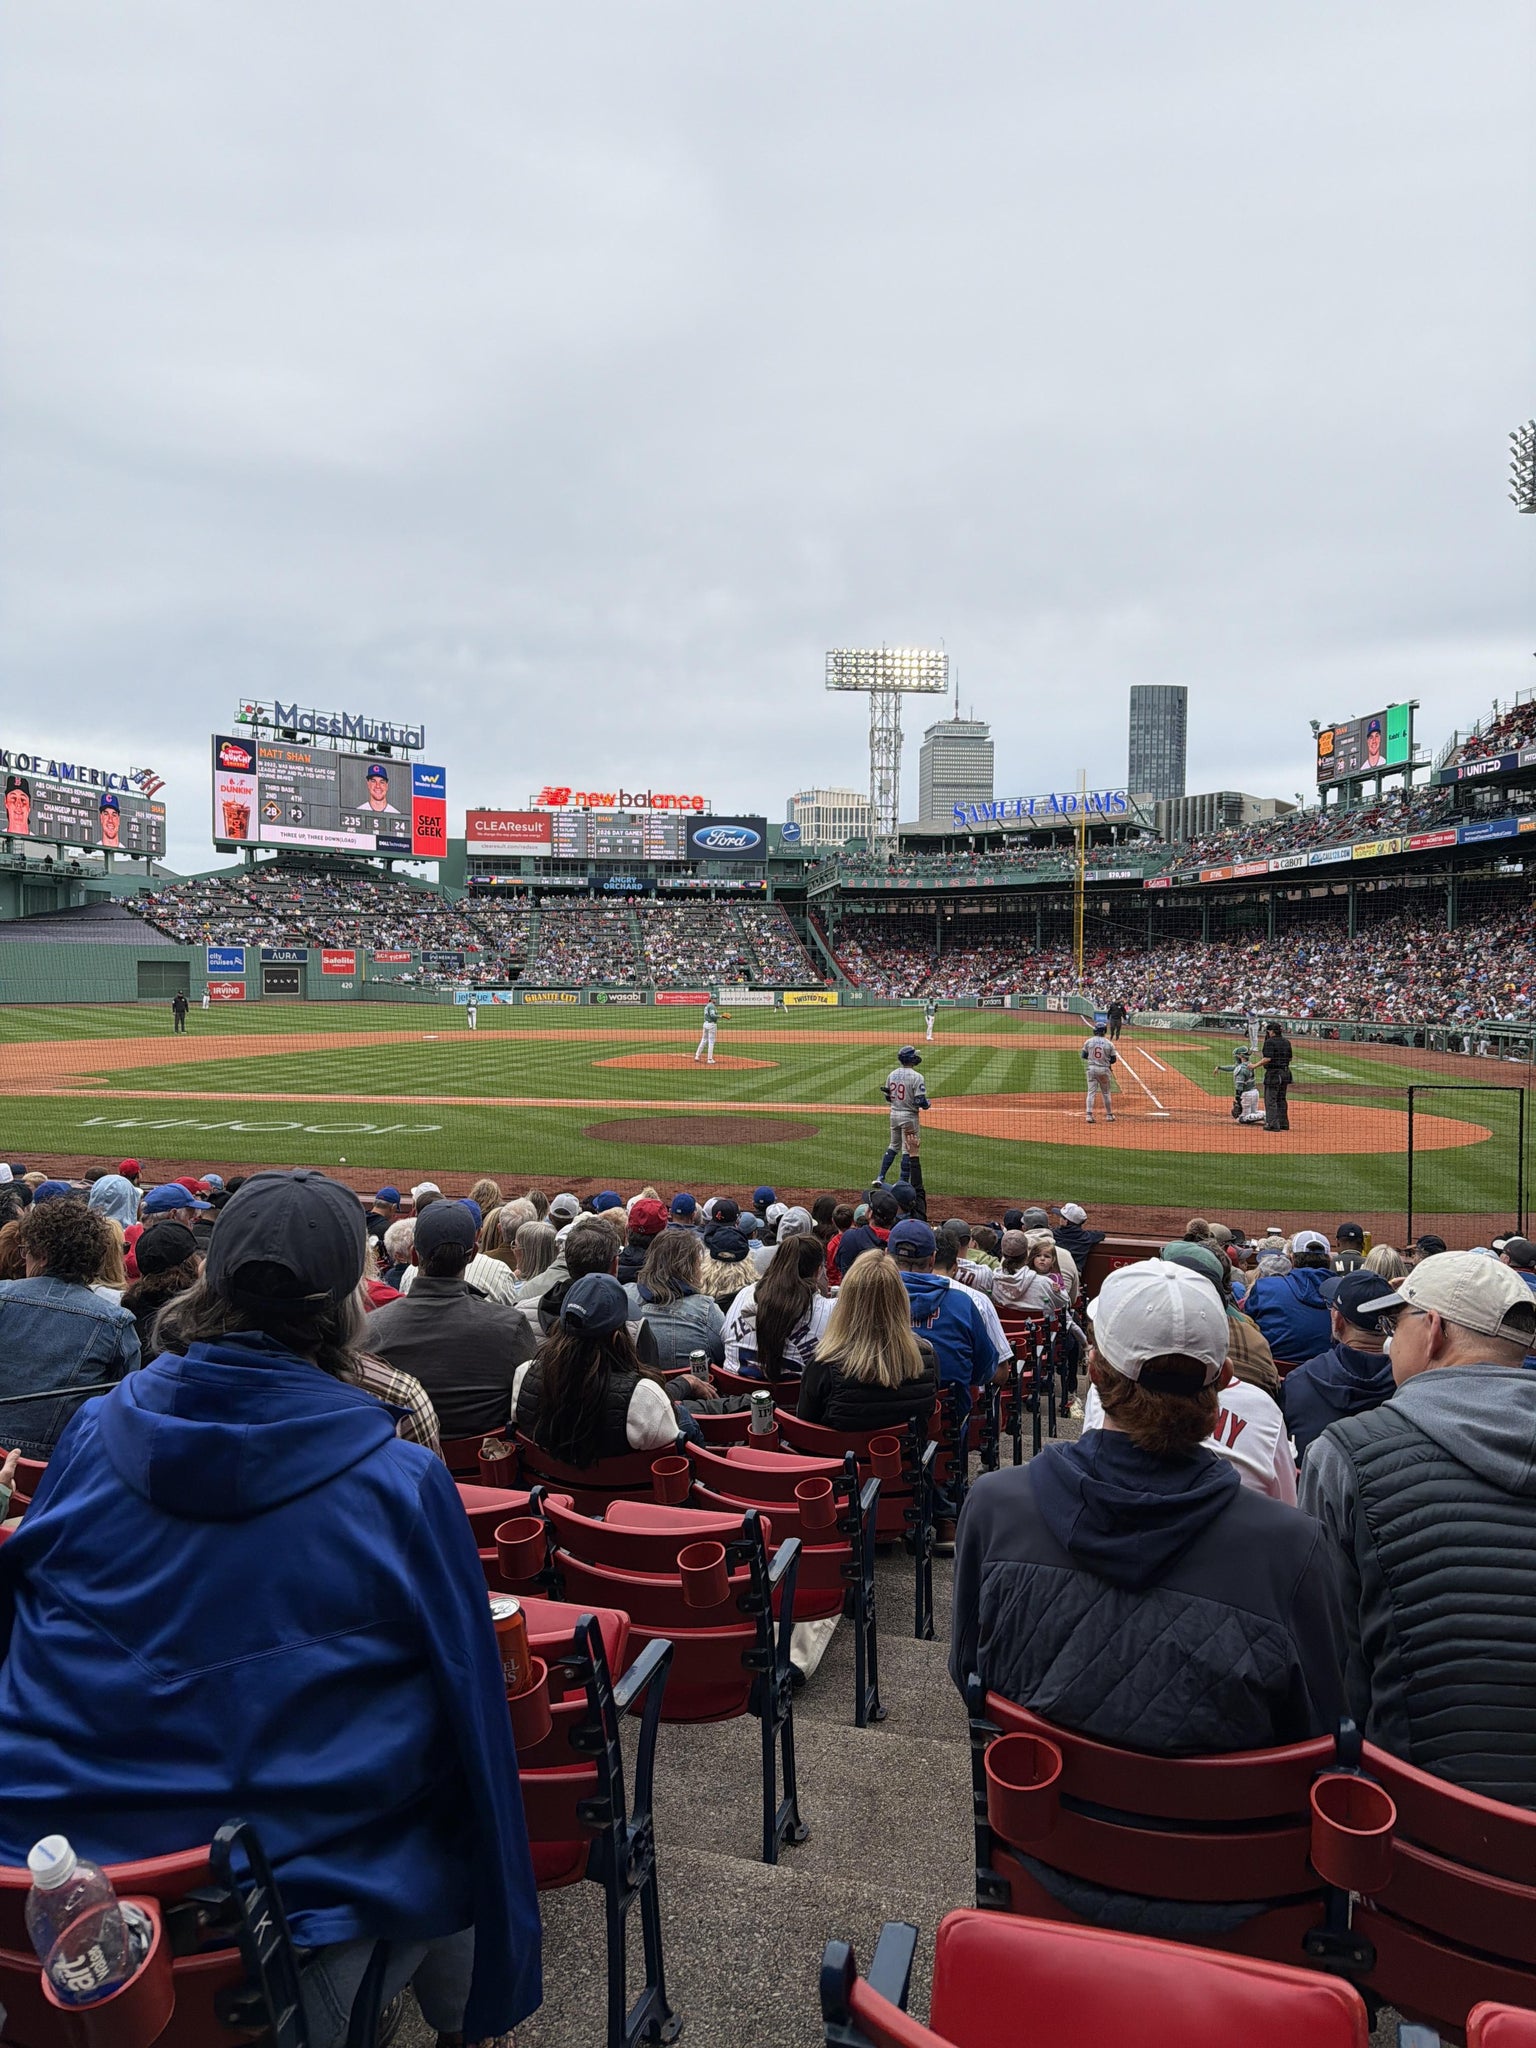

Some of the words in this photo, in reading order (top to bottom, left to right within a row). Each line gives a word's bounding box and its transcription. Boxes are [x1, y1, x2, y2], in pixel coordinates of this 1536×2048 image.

[274, 700, 425, 750] MassMutual
[259, 747, 283, 760] MATT
[286, 751, 312, 764] SHAW
[16, 753, 42, 774] OF
[46, 759, 130, 792] AMERICA
[1467, 759, 1501, 777] UNITED
[220, 785, 254, 795] DUNKIN'
[265, 783, 280, 792] THIRD
[280, 785, 295, 794] BASE
[290, 795, 303, 803] 4TH
[575, 791, 616, 808] new
[619, 788, 705, 810] balance
[266, 807, 277, 816] 2B
[291, 810, 303, 819] P3
[953, 798, 1037, 827] SAMUEL
[1044, 790, 1128, 814] ADAMS
[37, 811, 53, 820] BALLS
[418, 815, 442, 827] SEAT
[341, 816, 361, 826] .235
[373, 819, 379, 828] 5
[394, 821, 406, 831] 24
[475, 820, 543, 832] CLEAResult
[417, 826, 442, 839] GEEK
[706, 828, 747, 847] Ford
[897, 879, 910, 888] 27
[209, 952, 222, 960] city
[323, 956, 355, 965] Safelite
[389, 953, 411, 962] TICKET
[213, 986, 240, 995] IRVING
[608, 992, 642, 1001] wasabi
[524, 993, 558, 1004] GRANITE
[560, 992, 578, 1004] CITY
[793, 995, 818, 1004] TWISTED
[817, 995, 828, 1004] TEA
[1094, 1046, 1102, 1059] 6
[889, 1082, 905, 1101] 29
[692, 1365, 707, 1374] IPA
